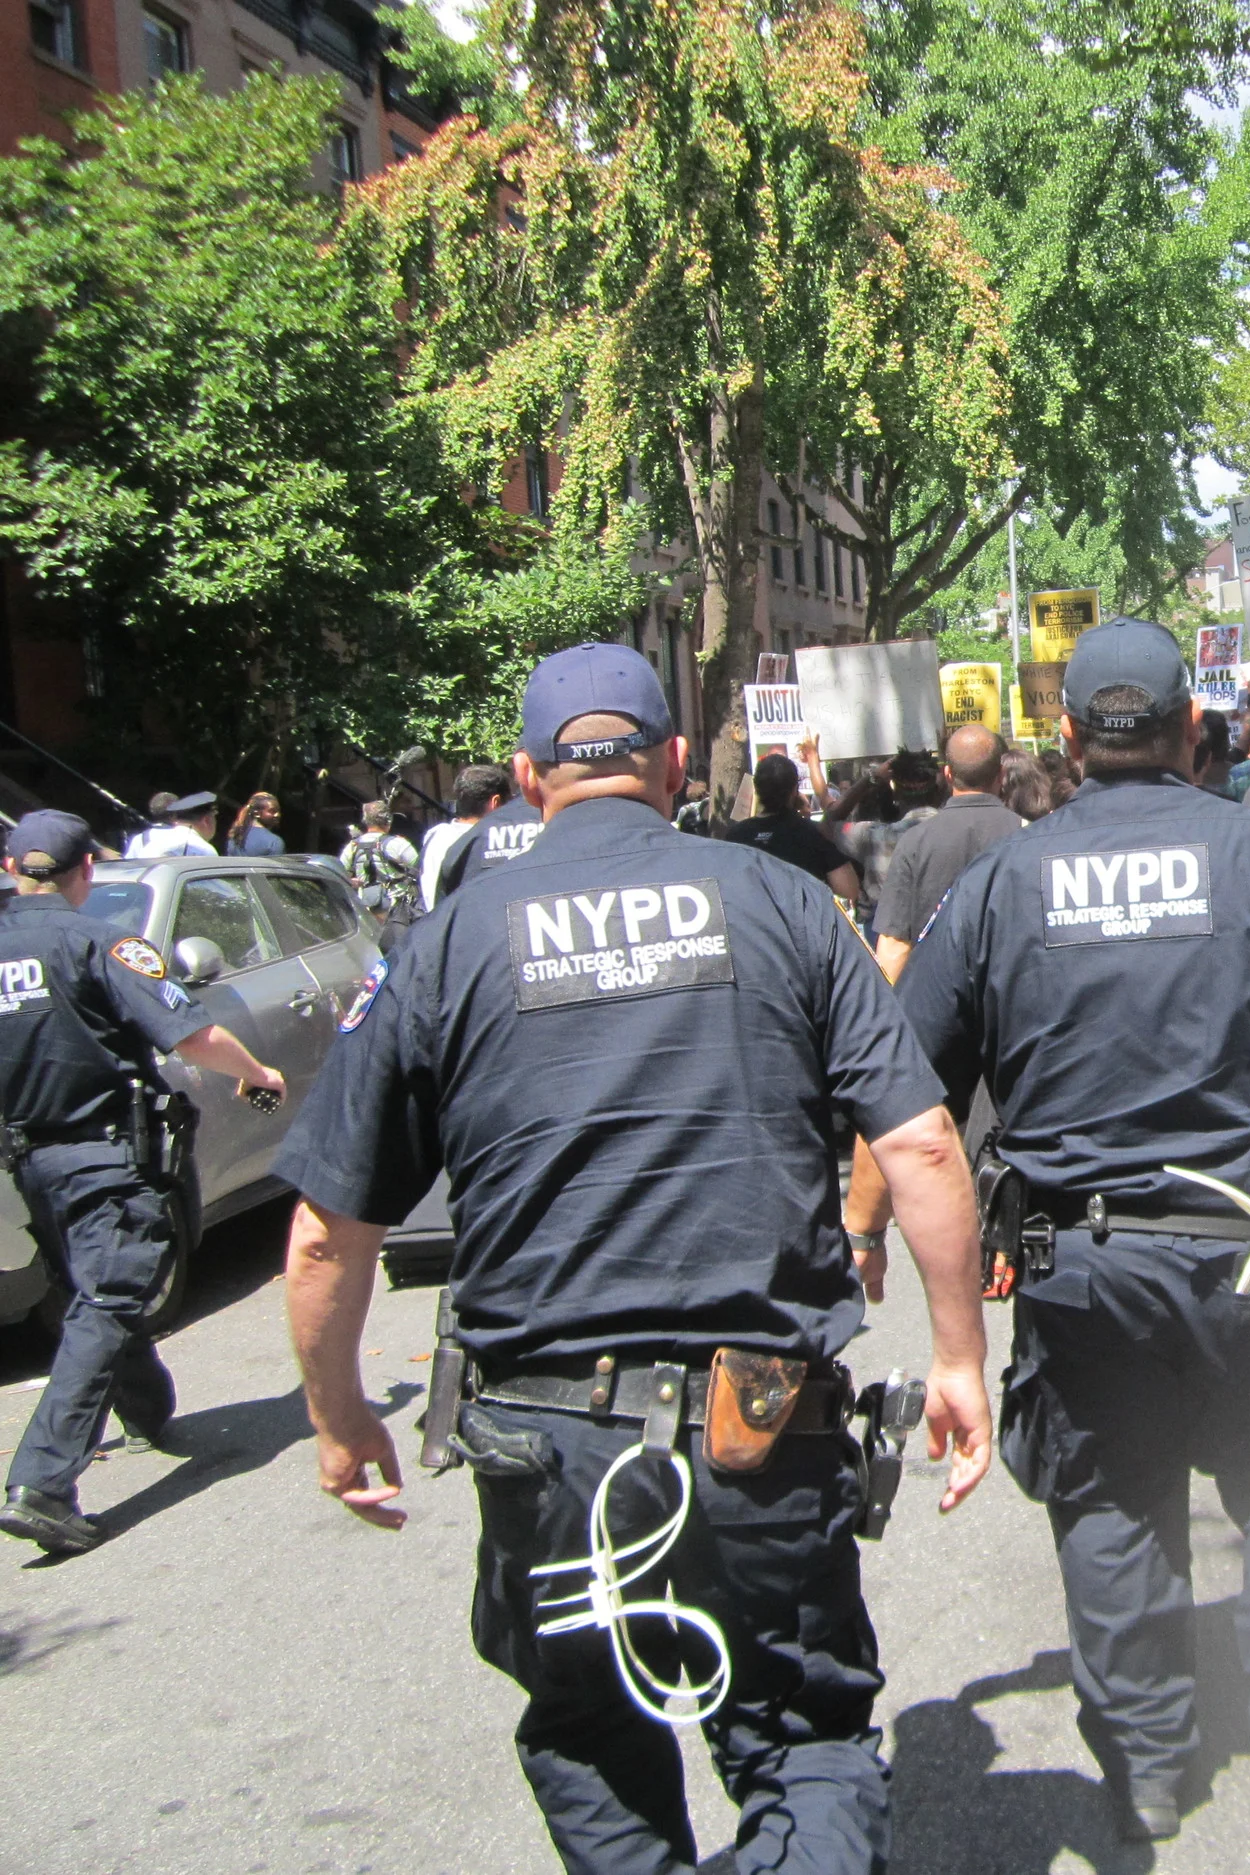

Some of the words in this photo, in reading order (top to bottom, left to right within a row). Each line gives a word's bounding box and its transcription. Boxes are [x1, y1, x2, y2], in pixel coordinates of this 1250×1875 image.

[1199, 669, 1236, 683] JAIL
[955, 697, 974, 709] END
[946, 710, 984, 723] RACIST
[1104, 716, 1135, 728] NYPD
[571, 743, 614, 758] NYPD
[1051, 850, 1199, 909] NYPD
[526, 885, 710, 957] NYPD
[1047, 904, 1125, 926] STRATEGIC
[1129, 899, 1208, 919] RESPONSE
[1101, 919, 1151, 936] GROUP
[523, 949, 624, 982] STRATEGIC
[631, 935, 726, 966] RESPONSE
[597, 966, 658, 990] GROUP
